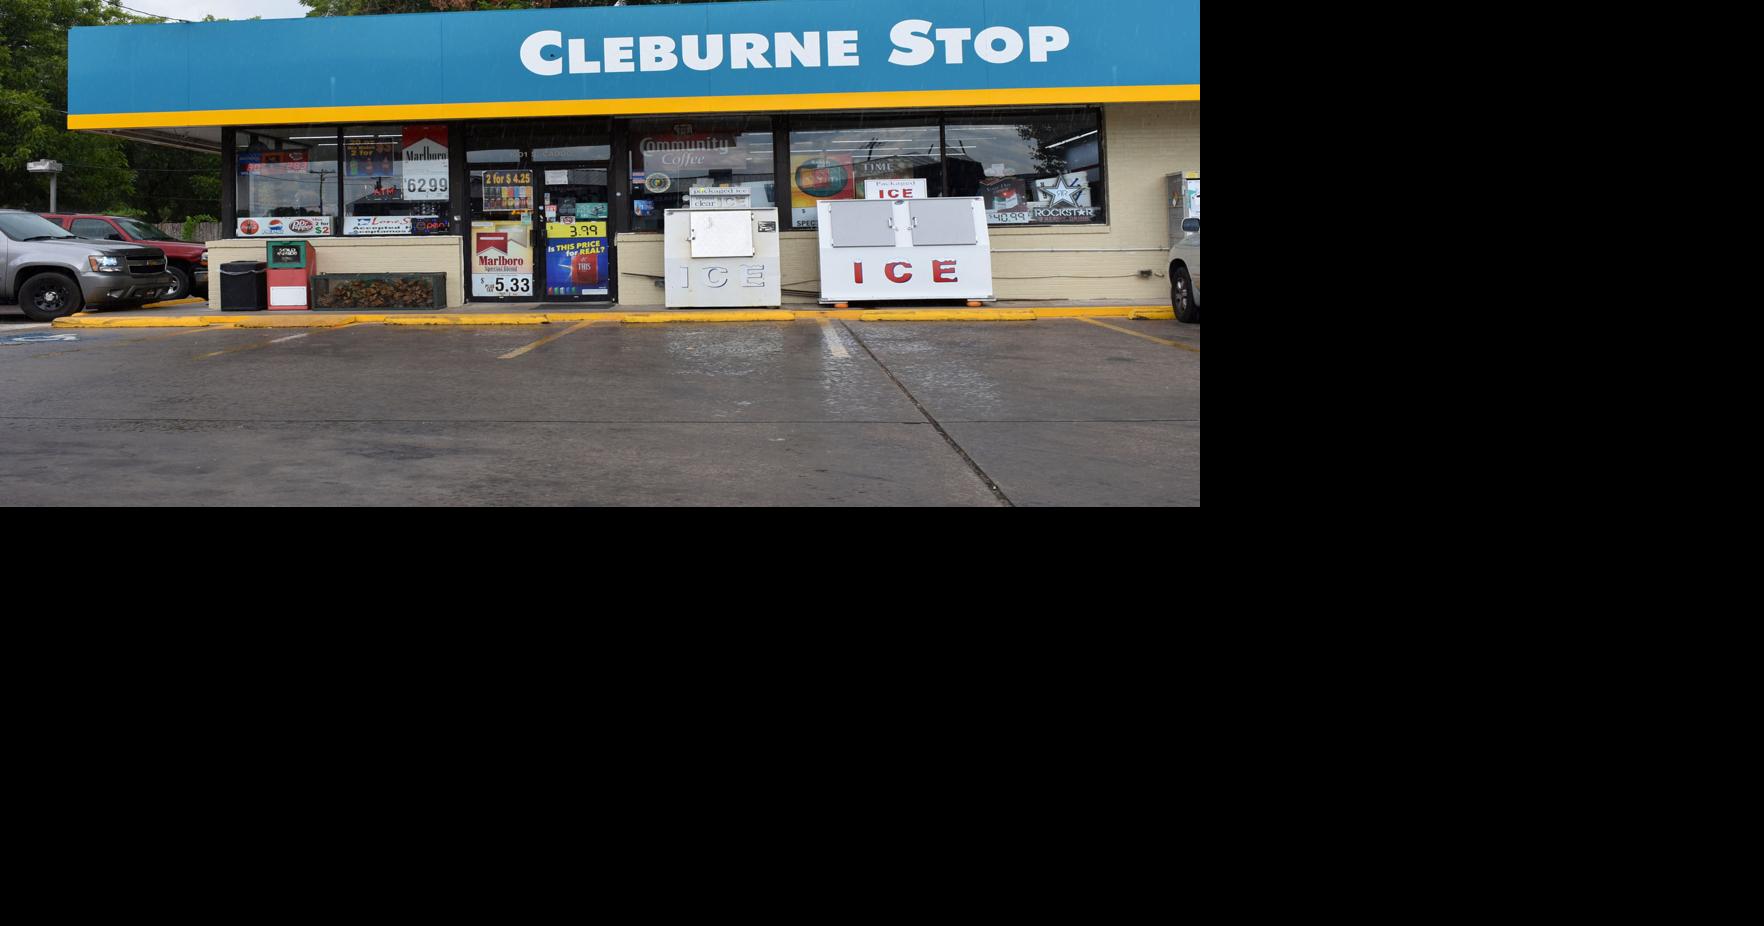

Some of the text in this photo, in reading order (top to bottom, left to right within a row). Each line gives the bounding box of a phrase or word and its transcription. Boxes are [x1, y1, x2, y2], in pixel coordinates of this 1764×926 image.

[639, 136, 728, 156] Community
[405, 145, 447, 161] Marlboro
[662, 152, 705, 167] Coffee
[486, 175, 491, 184] 2
[493, 174, 504, 184] for
[879, 189, 913, 199] ICE
[315, 226, 330, 234] $2
[569, 225, 598, 237] 3.99
[576, 240, 601, 249] PRICE
[580, 246, 605, 255] REAL?
[479, 256, 524, 266] Marlboro
[679, 264, 766, 288] ICE
[853, 260, 958, 284] ICE
[495, 277, 530, 292] 5.33
